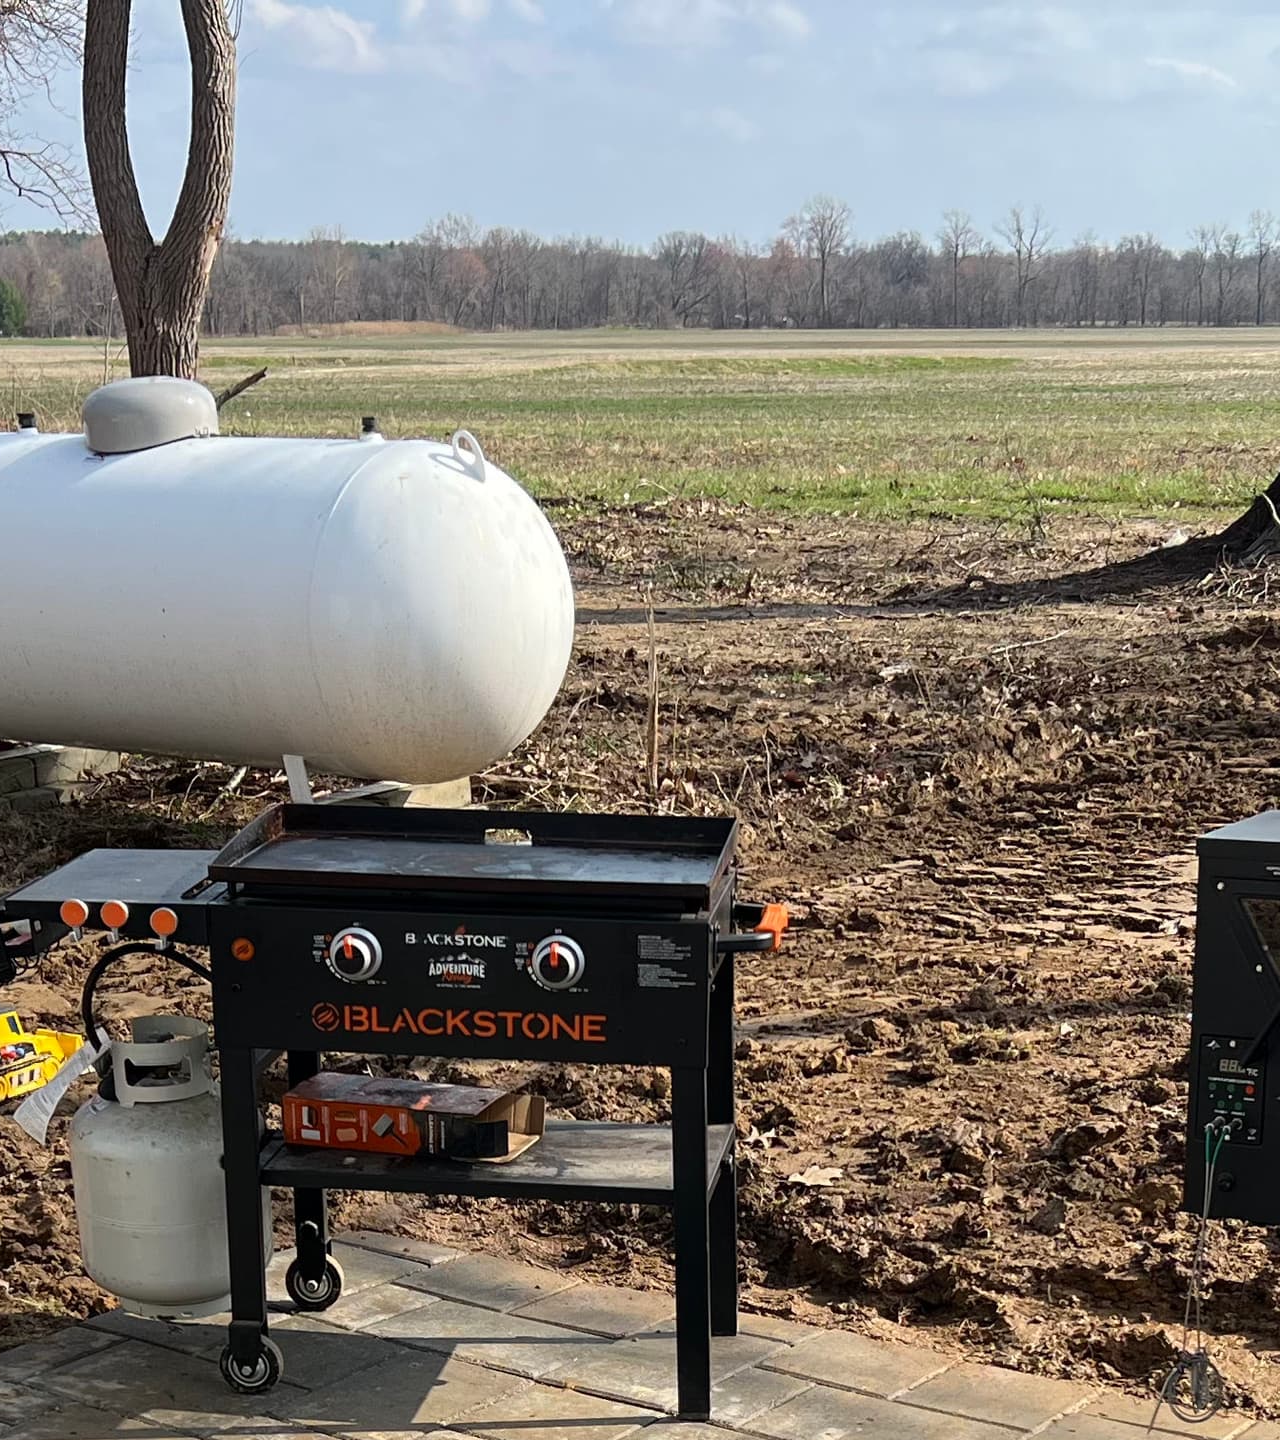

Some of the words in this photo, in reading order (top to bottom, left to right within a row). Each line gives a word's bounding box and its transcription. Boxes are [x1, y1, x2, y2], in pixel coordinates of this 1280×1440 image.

[404, 932, 507, 948] BACKSTONE
[428, 962, 486, 979] ADVENTURE
[343, 1004, 608, 1042] BLACKSTONE
